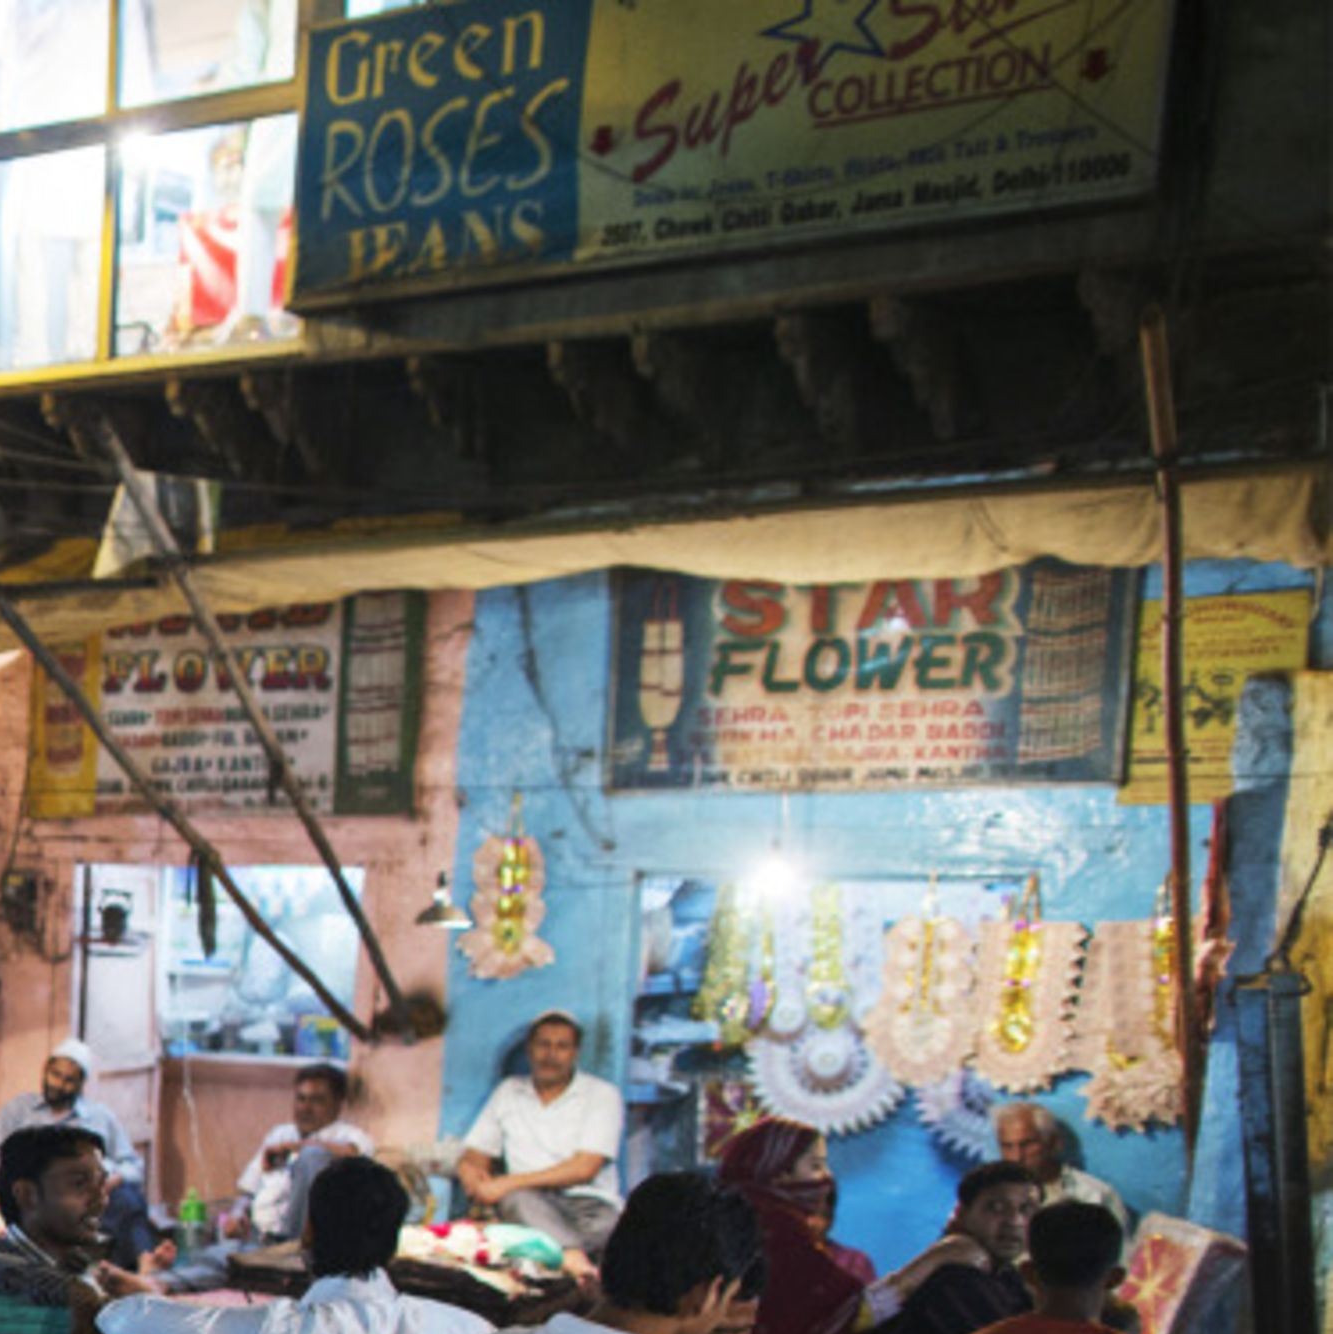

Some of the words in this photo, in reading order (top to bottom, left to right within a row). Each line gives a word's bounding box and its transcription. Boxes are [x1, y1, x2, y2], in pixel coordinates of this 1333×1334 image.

[326, 11, 544, 105] Green
[808, 44, 1052, 118] COLLECTION
[632, 38, 822, 184] Super
[321, 78, 570, 219] ROSES
[721, 576, 1004, 637] STAR
[709, 632, 1006, 697] FLOWER
[698, 705, 790, 726] SEHRA
[879, 699, 986, 719] SEHRA
[810, 721, 917, 743] CHADAR
